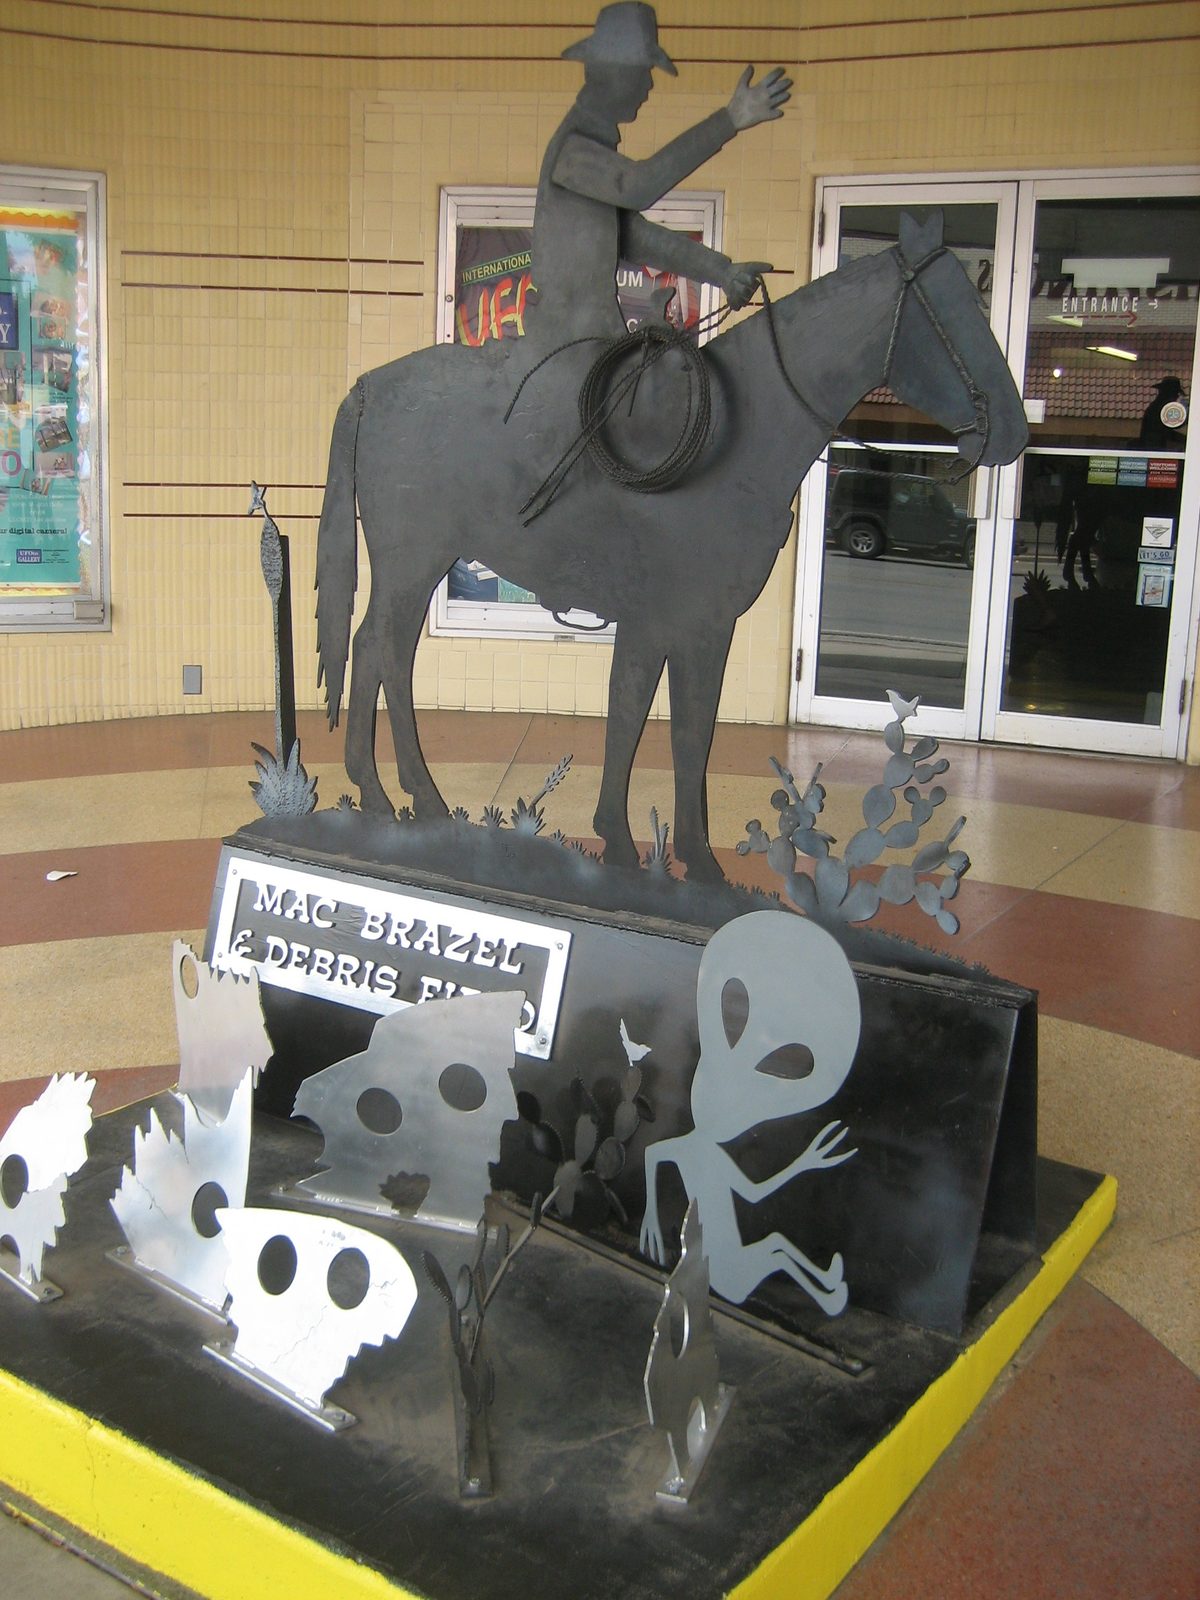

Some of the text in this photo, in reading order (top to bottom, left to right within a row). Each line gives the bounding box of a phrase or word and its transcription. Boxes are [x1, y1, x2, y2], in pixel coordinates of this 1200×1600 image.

[462, 253, 532, 283] INTERNATIONA
[617, 271, 643, 288] UM
[1061, 296, 1139, 313] ENTRANCE
[9, 527, 35, 535] digital
[1139, 551, 1157, 560] LET'S
[253, 880, 523, 975] MAC BRAZEL
[264, 934, 400, 999] DEBRIS
